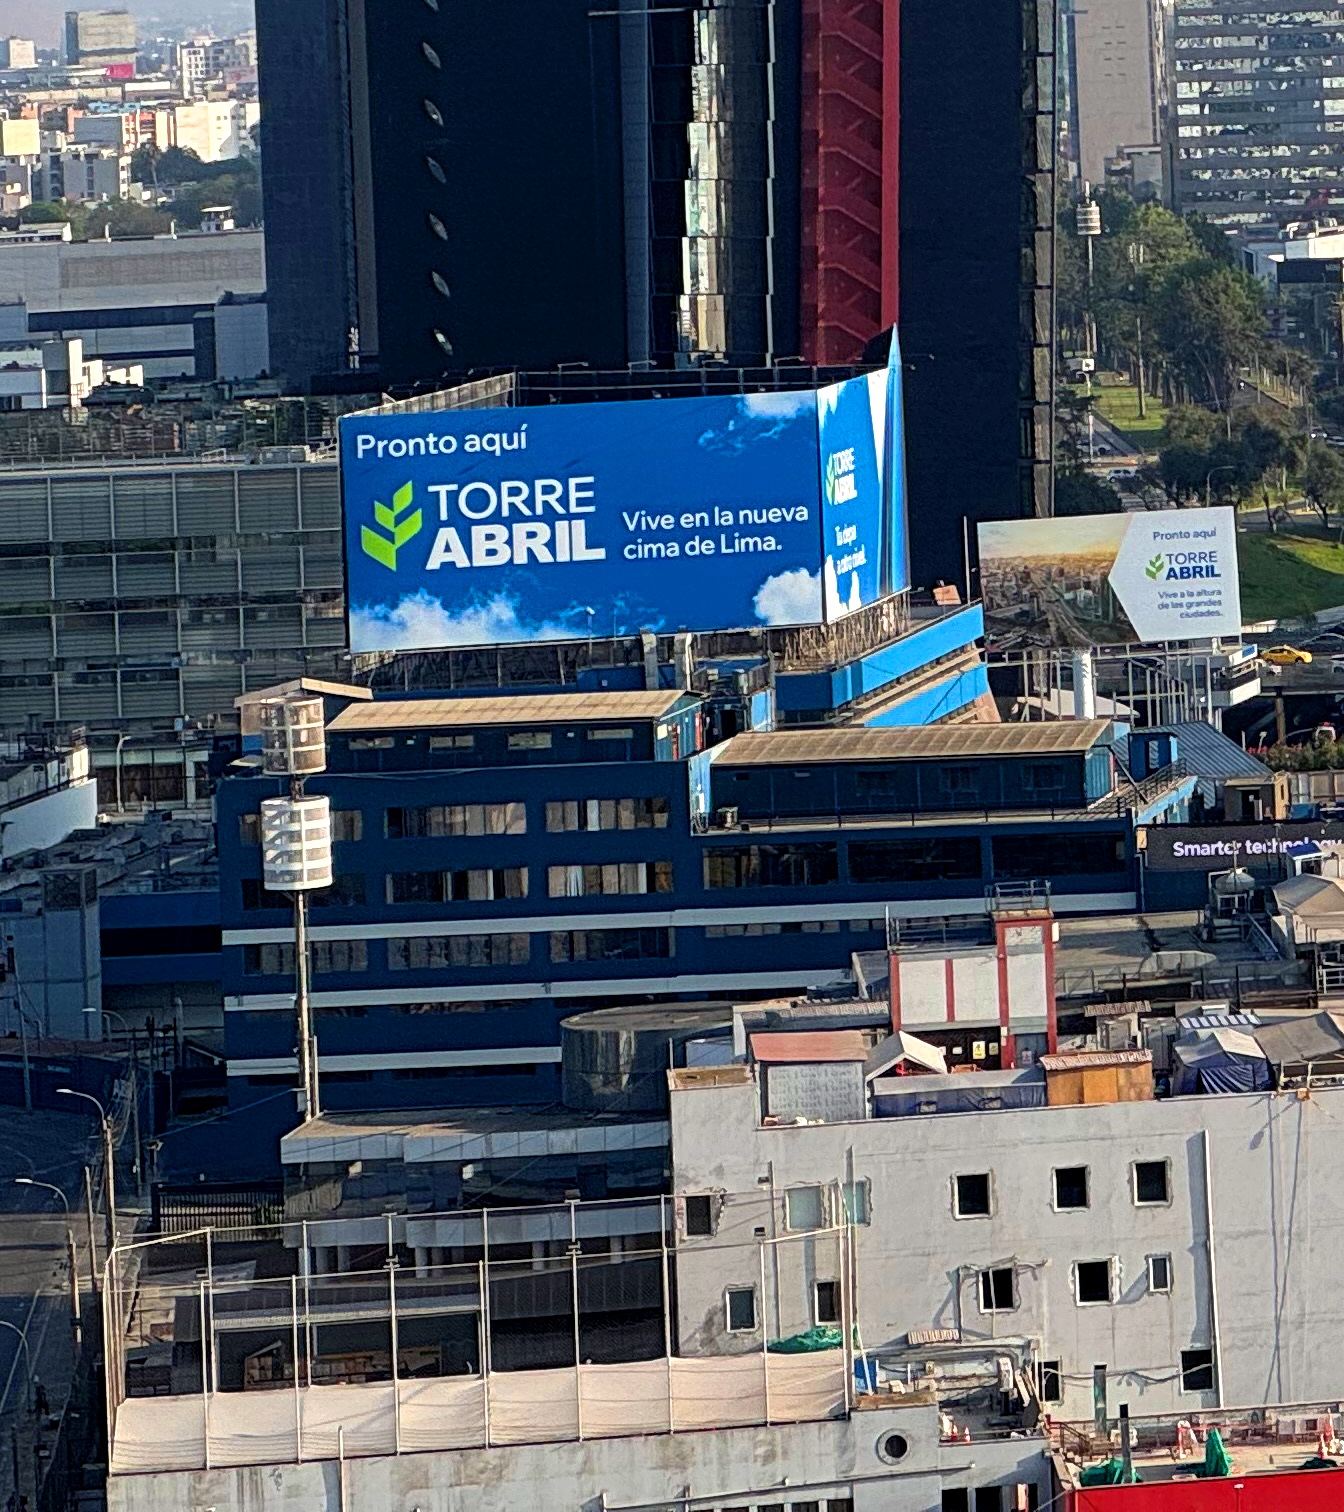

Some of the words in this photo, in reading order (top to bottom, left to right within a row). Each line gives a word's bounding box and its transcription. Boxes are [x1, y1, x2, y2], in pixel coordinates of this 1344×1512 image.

[356, 432, 458, 459] Pronto
[464, 423, 528, 457] aquí
[427, 476, 596, 521] TORRE
[622, 509, 675, 531] Vive
[680, 511, 709, 529] en
[714, 506, 734, 527] la
[739, 505, 809, 525] nueva
[1153, 530, 1191, 541] Pronto
[1192, 526, 1217, 540] aquí
[425, 519, 606, 571] ABRIL
[623, 538, 680, 560] cima
[685, 535, 715, 556] de
[720, 532, 783, 555] Lima.
[1165, 551, 1218, 565] TORRE
[1165, 565, 1221, 581] ABRIL
[1158, 591, 1178, 599] Vive
[1157, 602, 1170, 610] de
[1171, 601, 1184, 609] las
[1185, 598, 1222, 609] grandes
[1180, 609, 1224, 619] ciudades.
